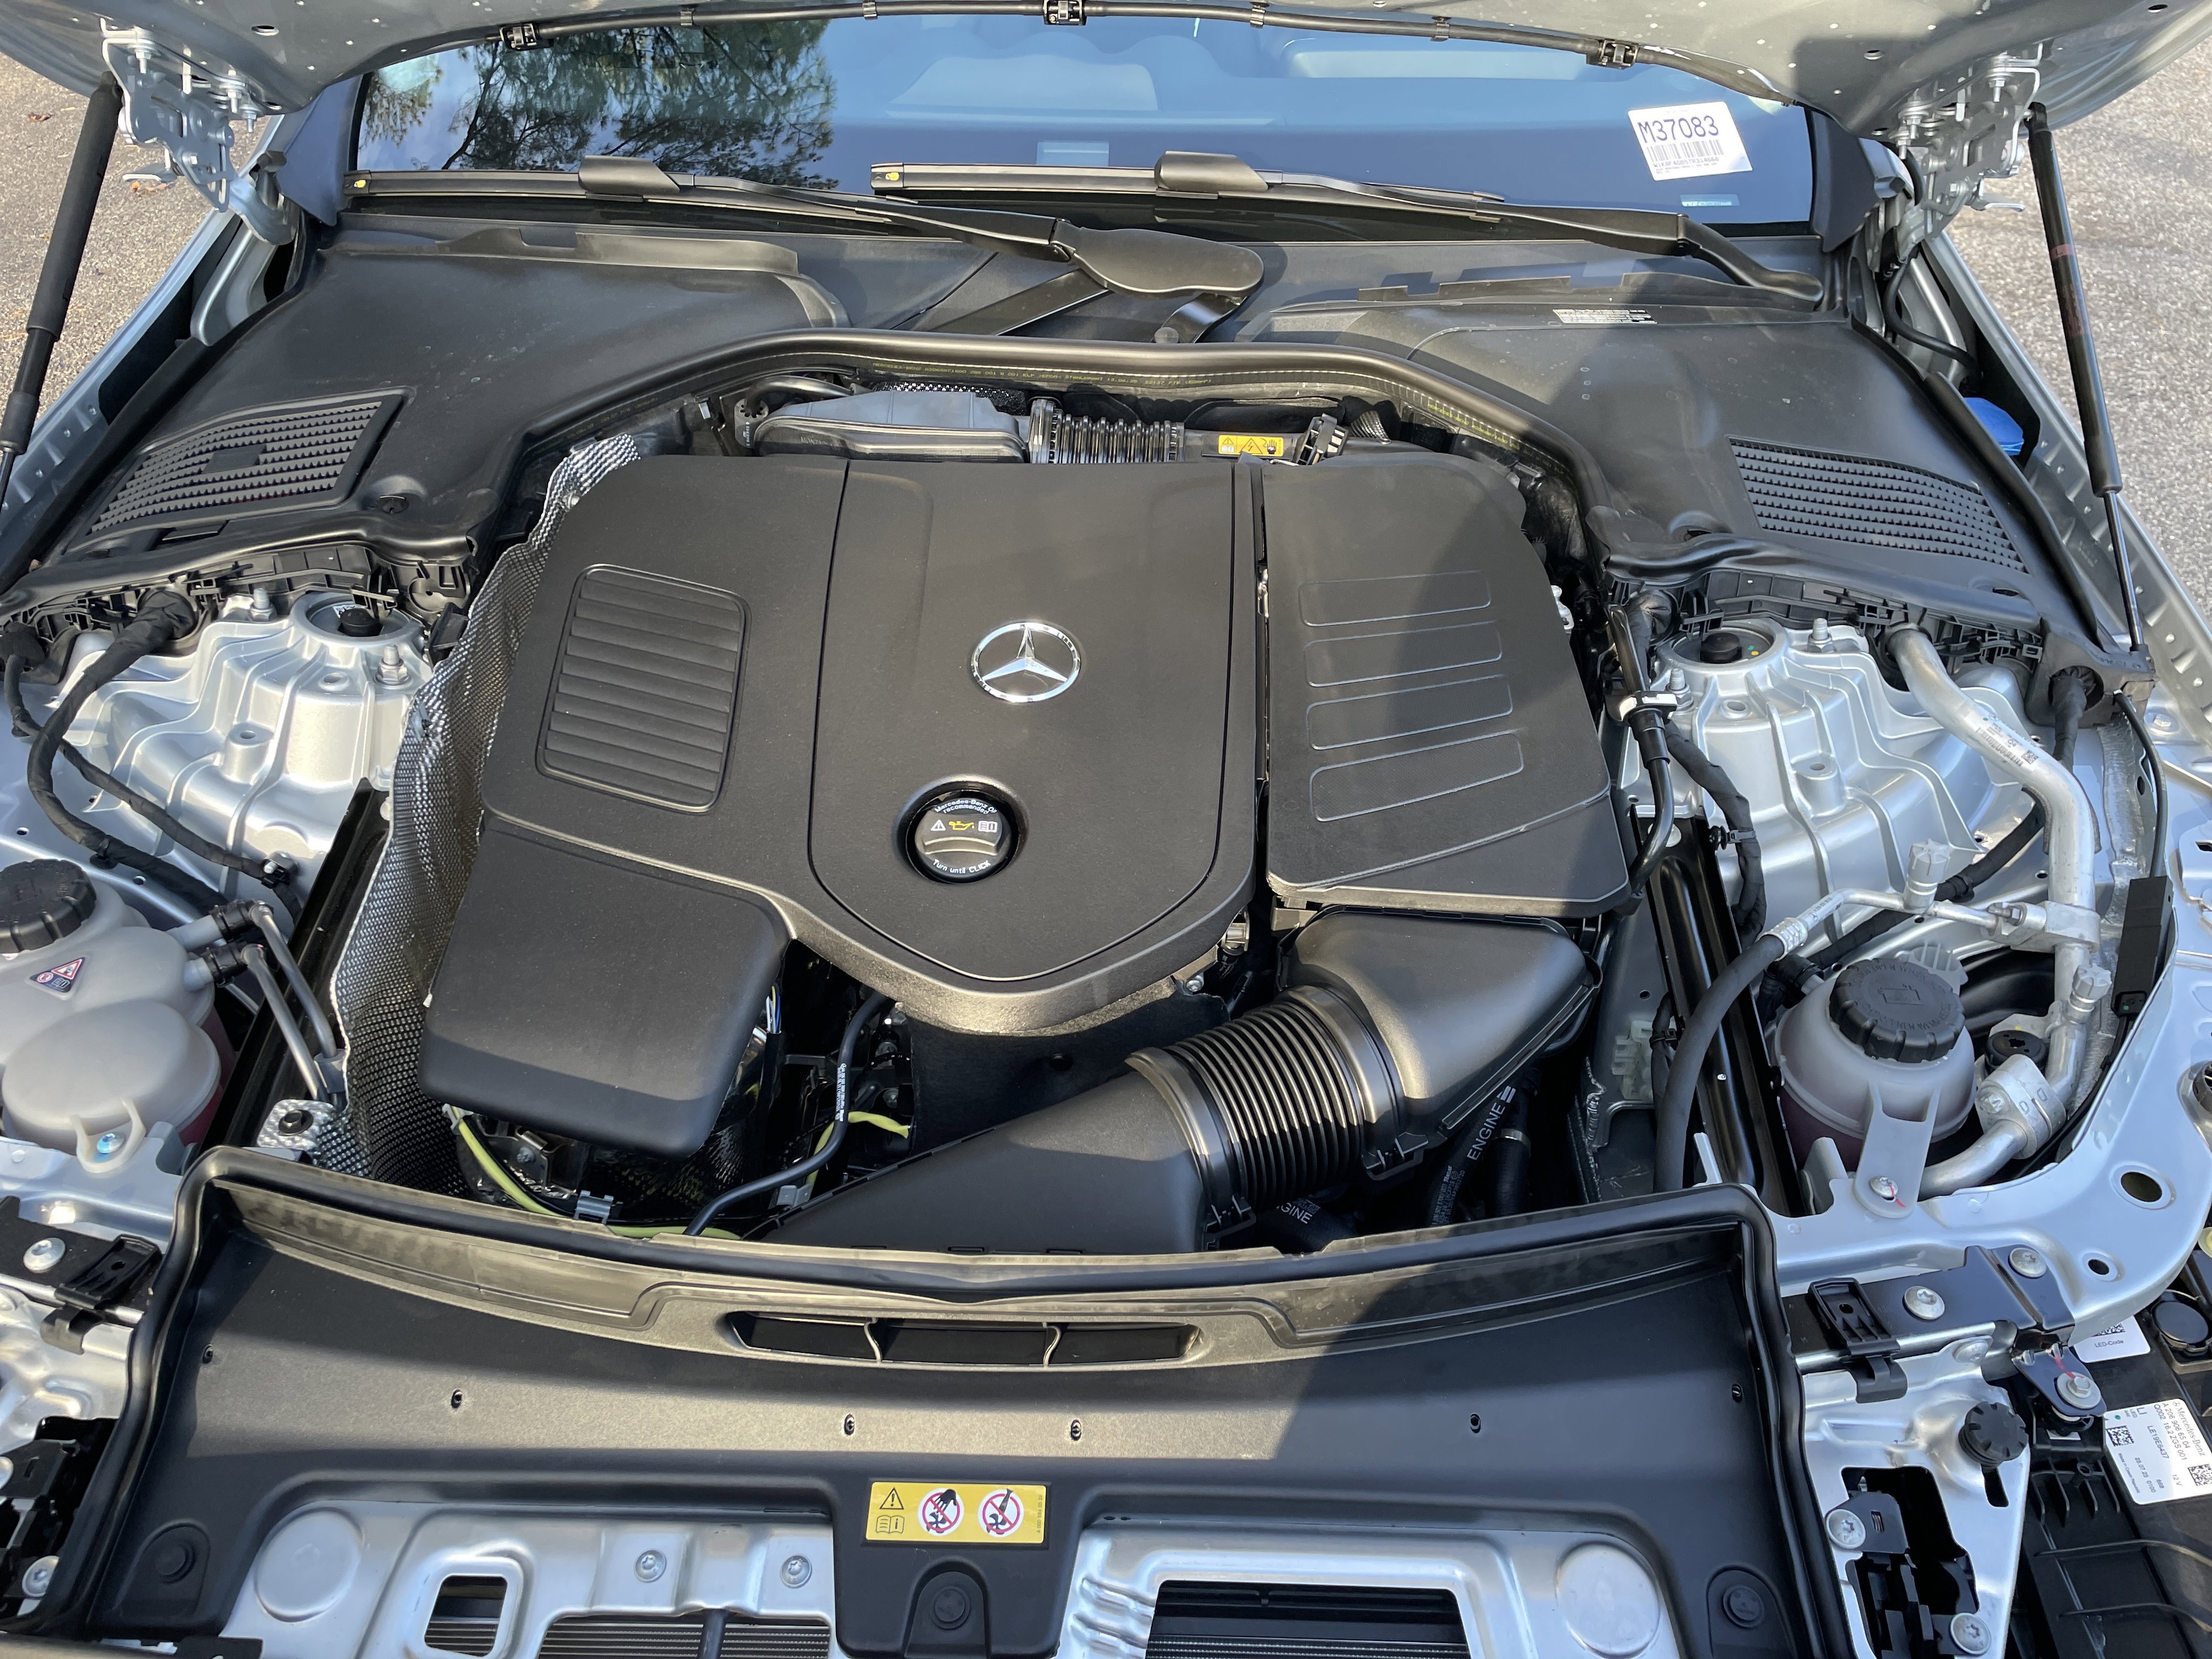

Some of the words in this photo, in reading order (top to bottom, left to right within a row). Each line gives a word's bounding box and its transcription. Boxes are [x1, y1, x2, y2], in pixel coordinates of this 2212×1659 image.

[1637, 115, 1719, 143] M37083
[934, 799, 989, 813] Mercedes-Benz
[943, 804, 989, 815] recommended
[933, 859, 947, 871] Turn
[968, 860, 991, 873] CLICK
[1467, 1102, 1506, 1161] ENGINE
[1280, 1202, 1313, 1224] GINE
[2095, 1339, 2124, 1348] LED-Code
[2153, 1403, 2167, 1420] Q002
[2169, 1435, 2182, 1449] ZGS
[2177, 1449, 2187, 1460] 001
[2165, 1407, 2176, 1419] 206
[2171, 1419, 2182, 1431] 906
[2182, 1441, 2191, 1449] 04
[2176, 1407, 2205, 1457] Mercedes-Benz
